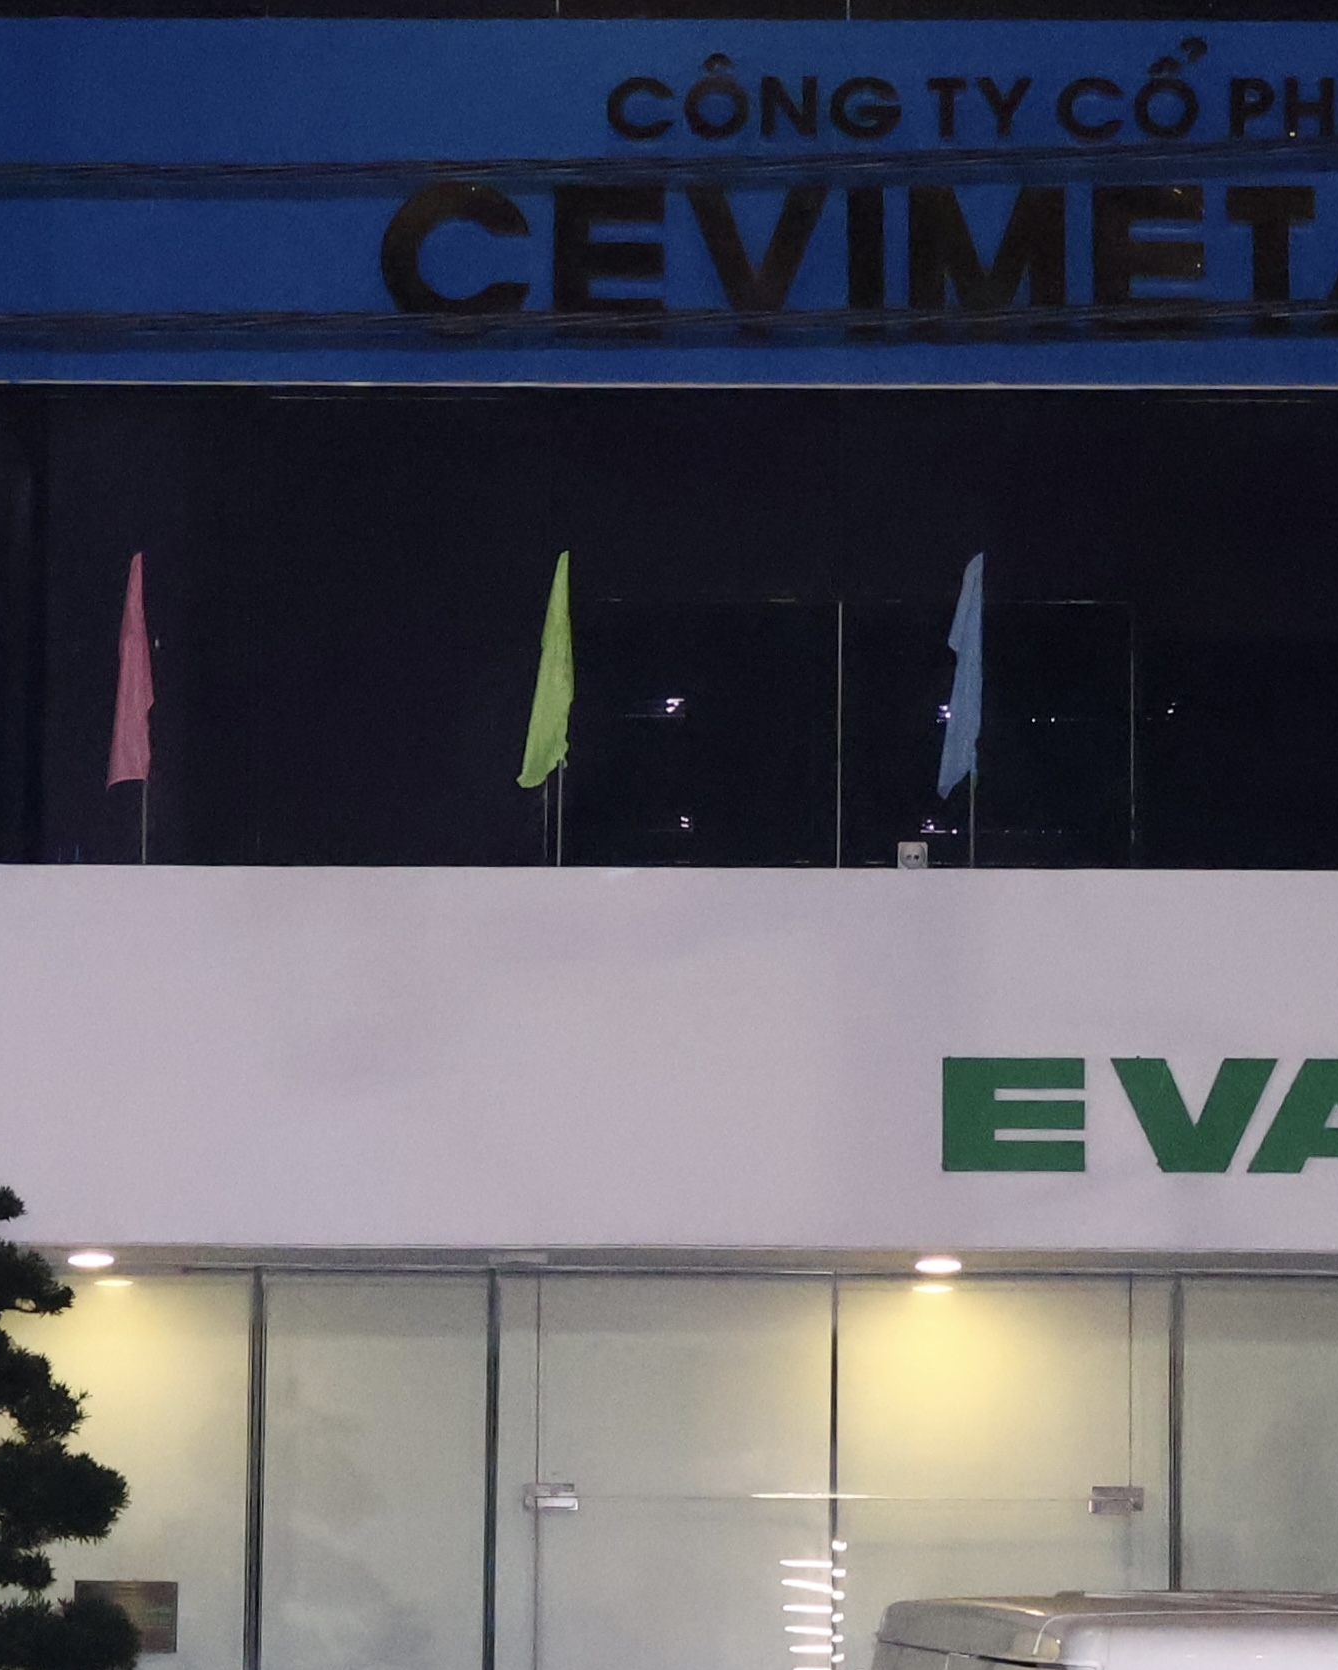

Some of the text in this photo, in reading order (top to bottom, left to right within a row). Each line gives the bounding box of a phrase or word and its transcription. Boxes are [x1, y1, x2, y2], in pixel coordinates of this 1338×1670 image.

[606, 53, 902, 140] CÔNG
[927, 76, 1032, 138] TY
[1056, 37, 1208, 141] CỔ
